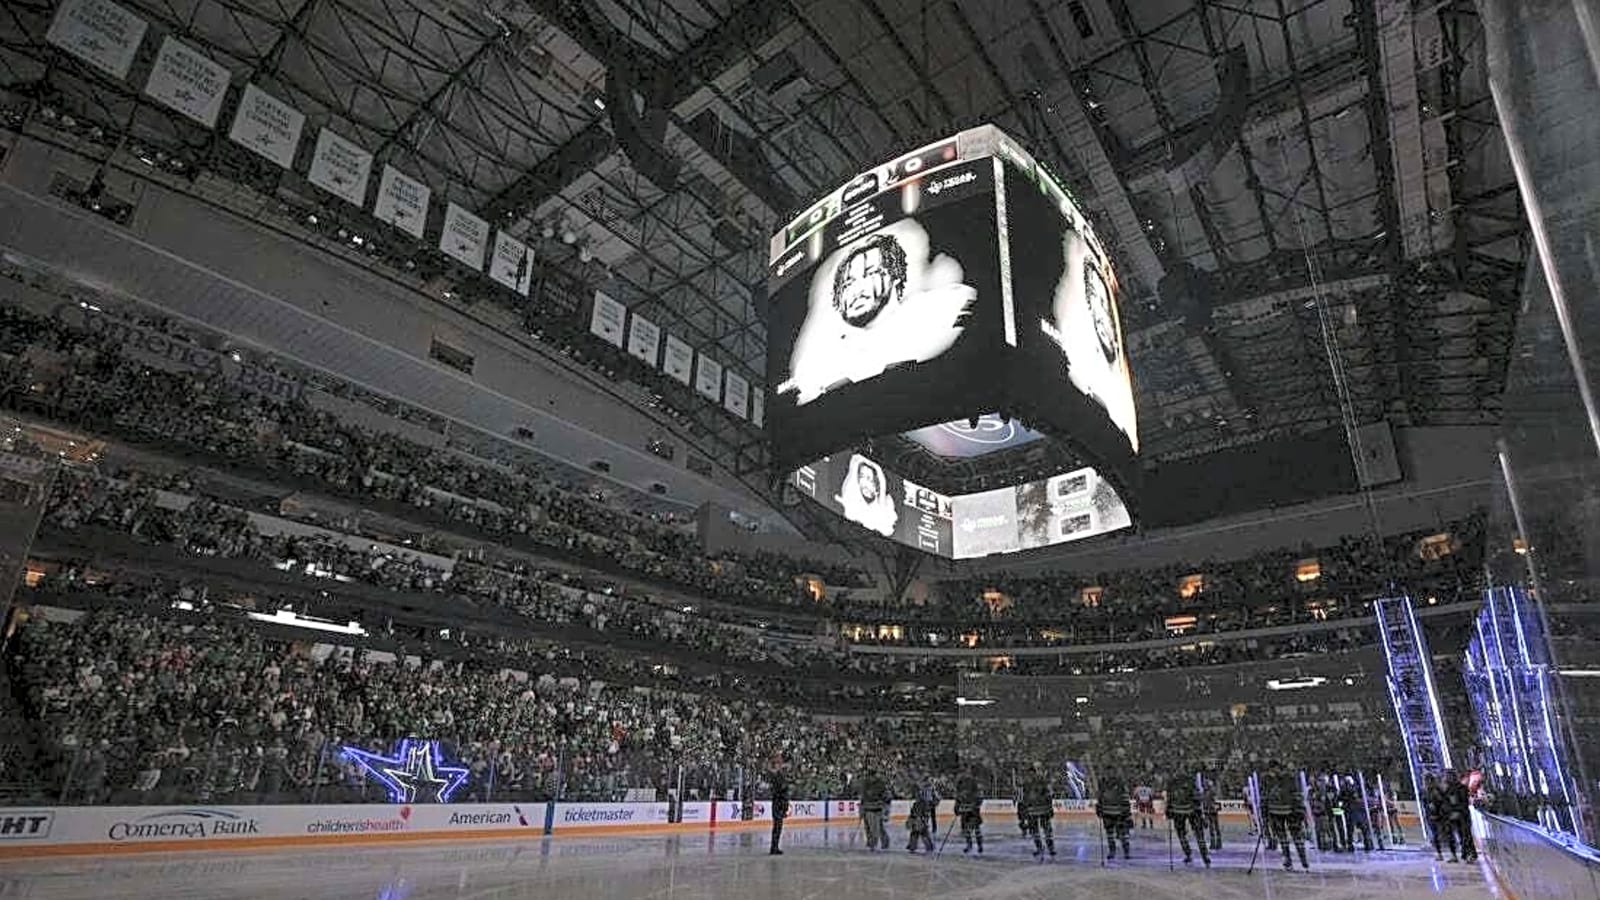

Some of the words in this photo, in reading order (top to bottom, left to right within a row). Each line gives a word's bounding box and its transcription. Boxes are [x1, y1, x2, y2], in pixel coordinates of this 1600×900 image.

[564, 807, 634, 822] ticketmaster
[795, 804, 815, 816] PNC
[0, 816, 48, 834] HT
[450, 811, 511, 825] American
[213, 817, 259, 835] Bank
